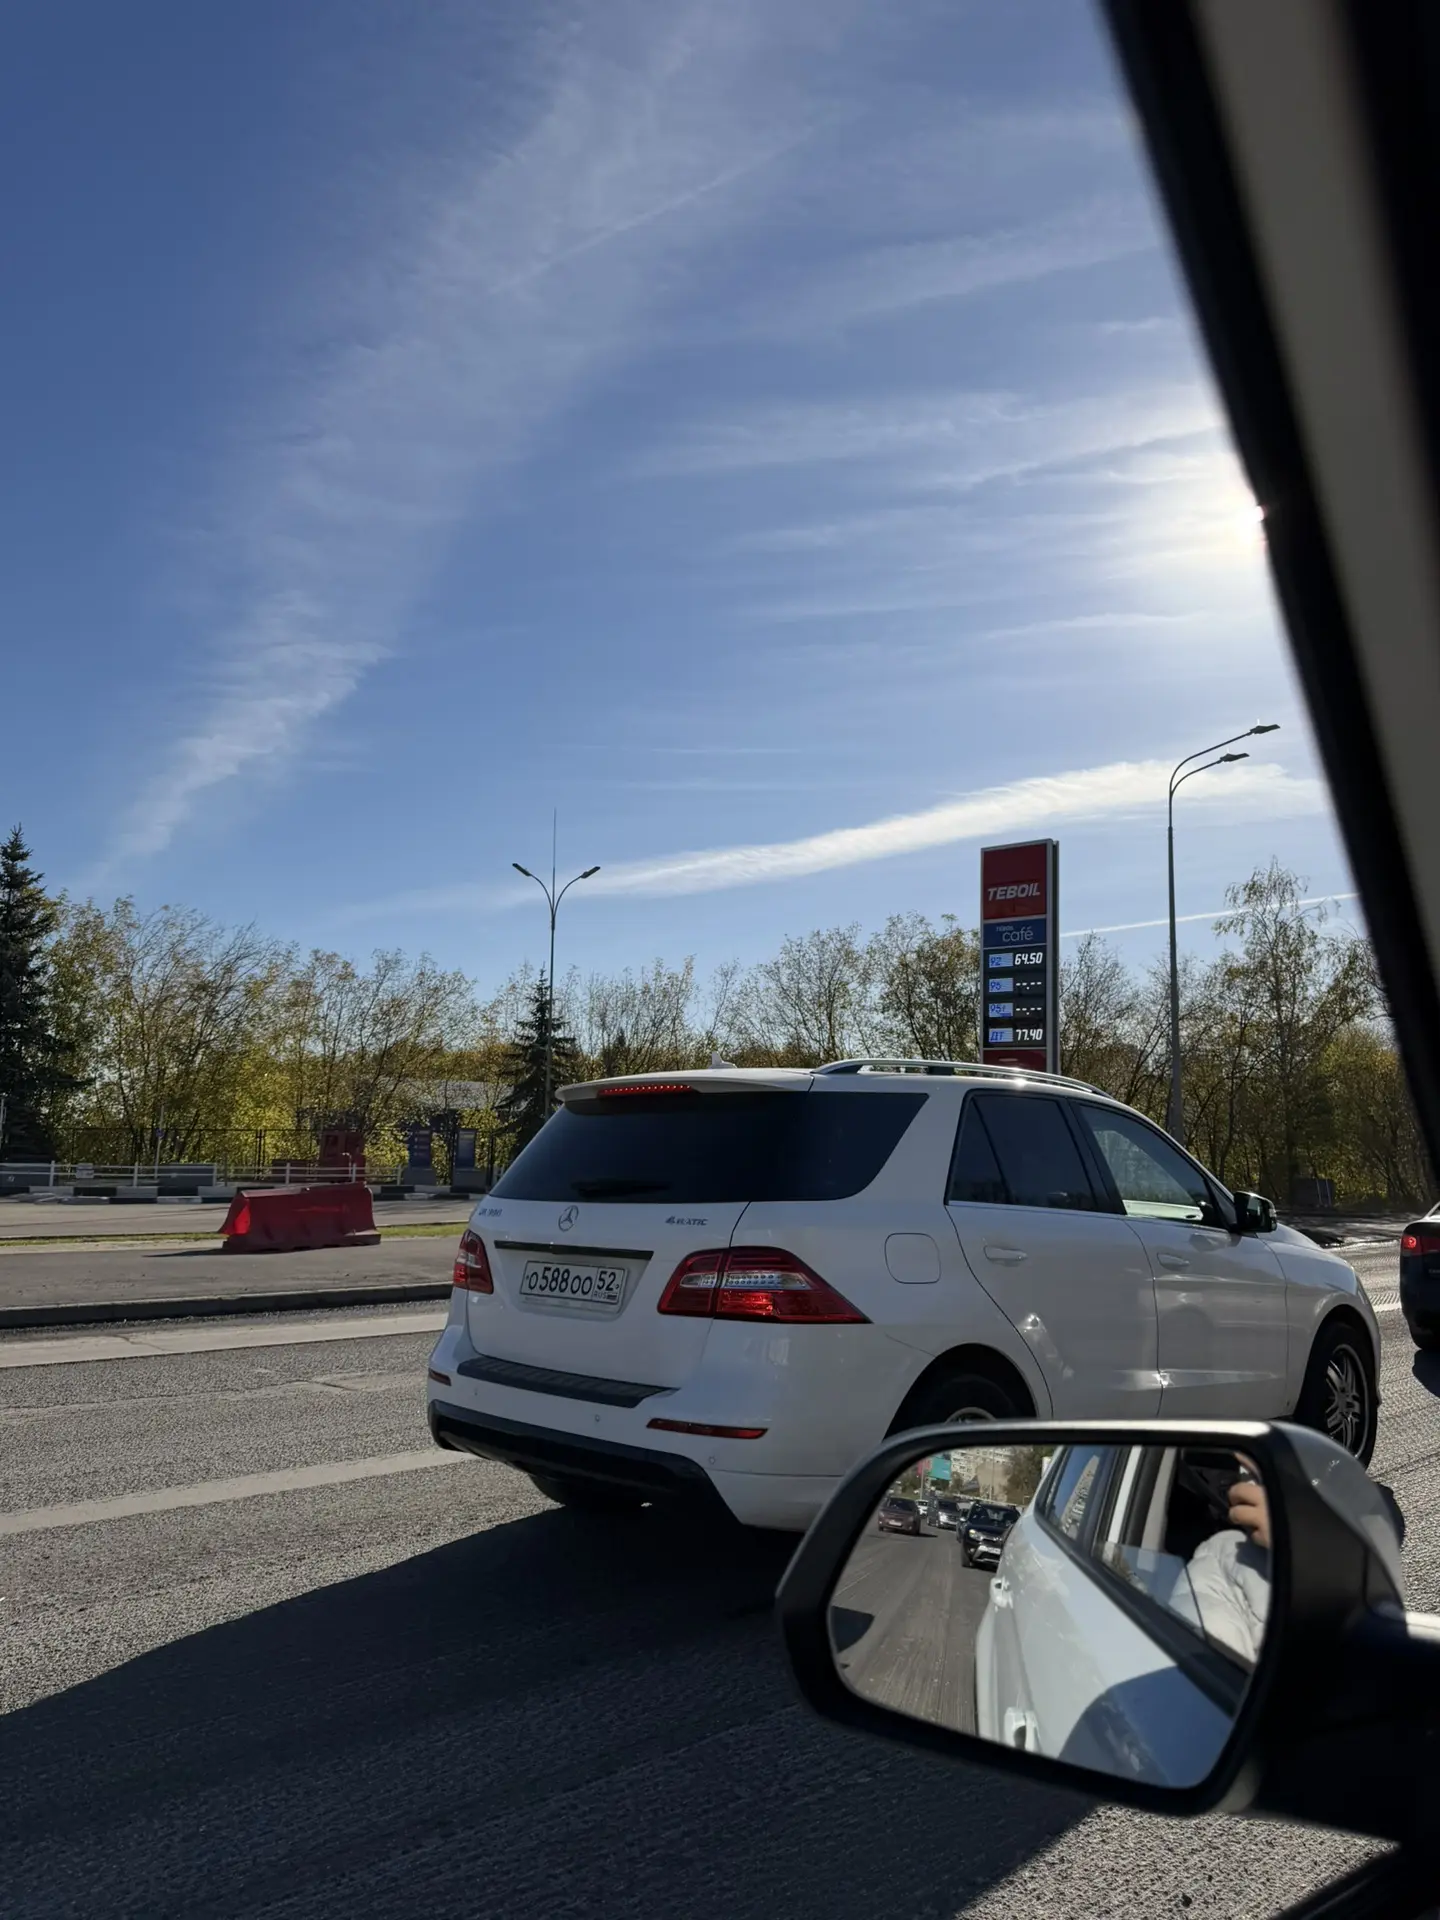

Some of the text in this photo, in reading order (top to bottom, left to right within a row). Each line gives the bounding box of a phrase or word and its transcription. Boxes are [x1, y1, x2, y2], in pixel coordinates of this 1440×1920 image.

[988, 883, 1040, 900] TEBOIL
[1002, 926, 1034, 942] café
[1015, 952, 1043, 965] 64.50
[1016, 1029, 1043, 1040] 77.40
